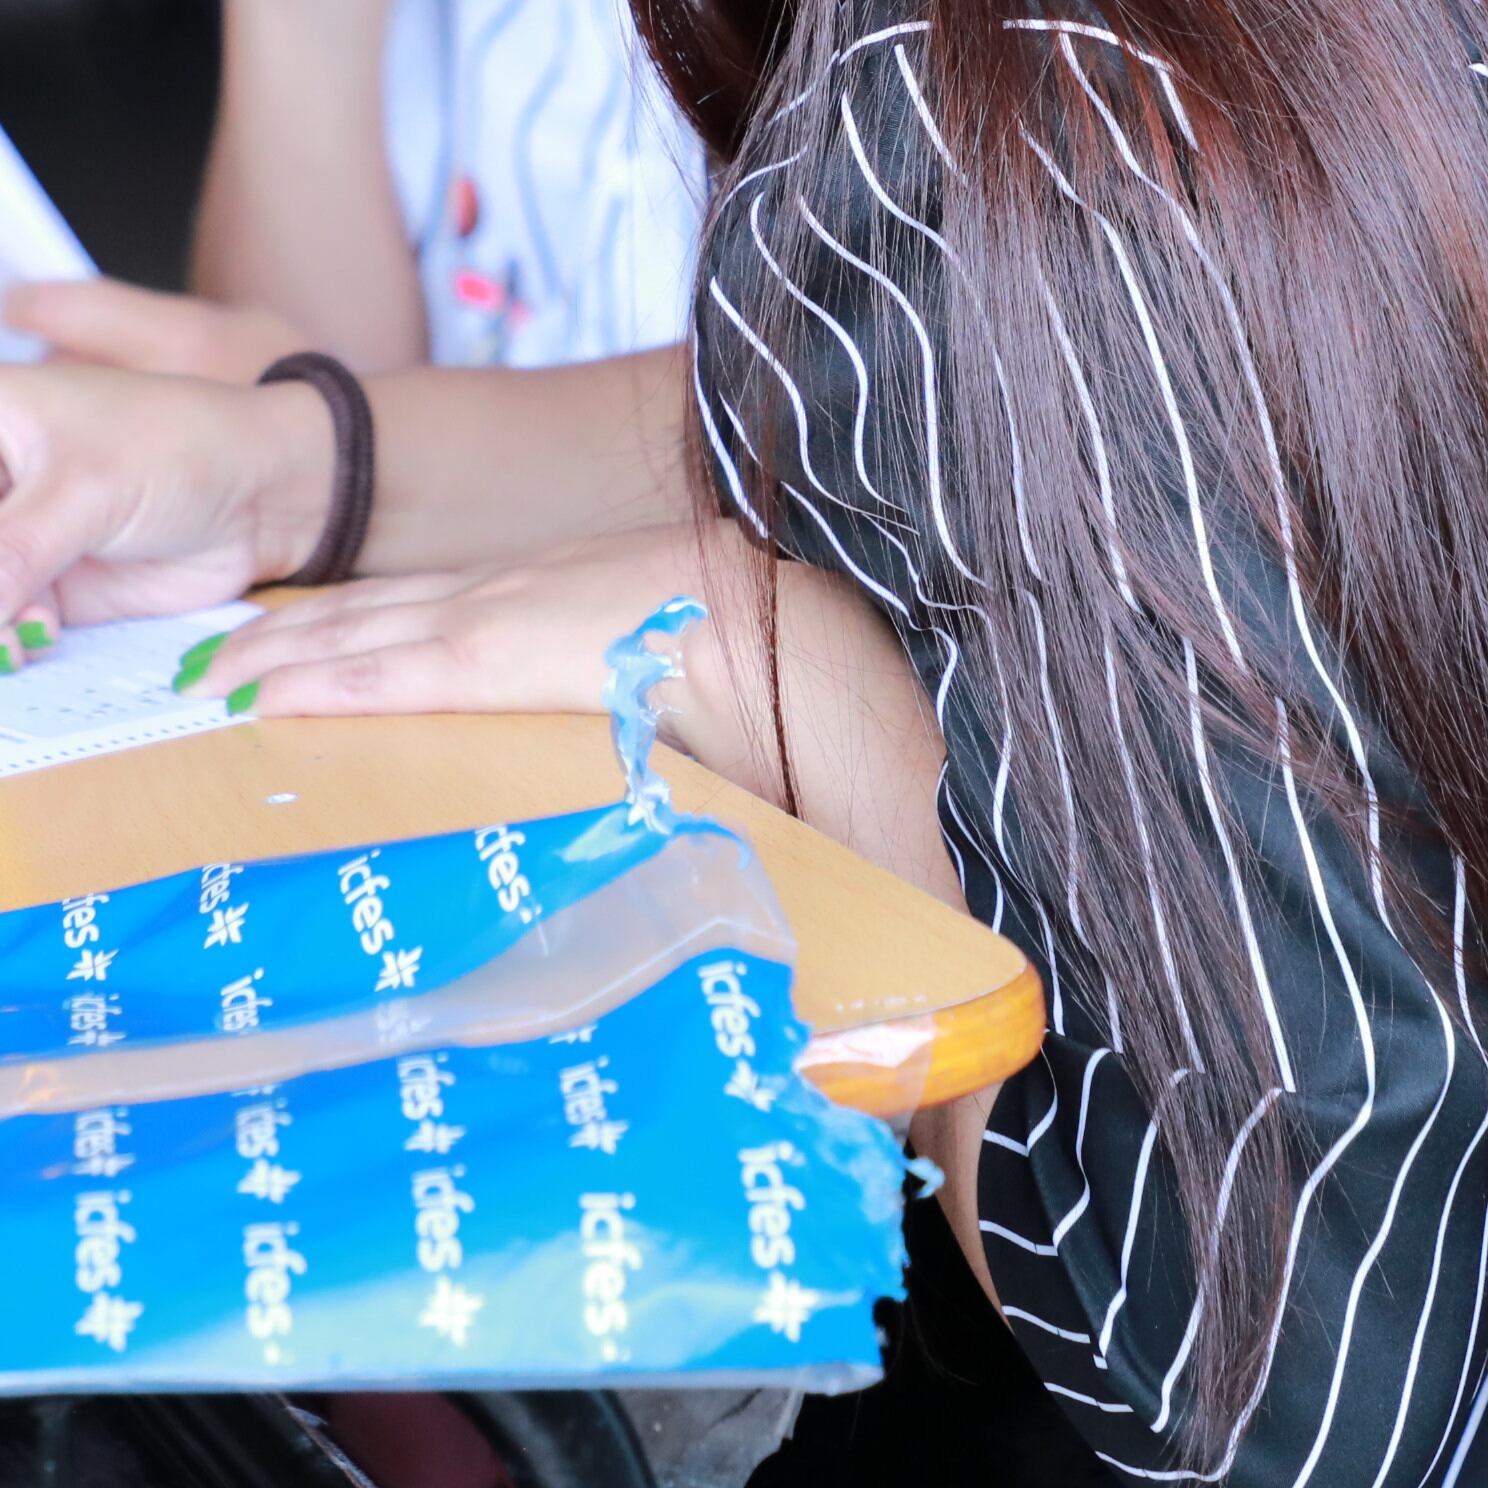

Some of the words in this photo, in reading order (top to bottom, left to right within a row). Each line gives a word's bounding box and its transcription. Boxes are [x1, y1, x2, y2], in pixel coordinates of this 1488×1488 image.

[338, 848, 390, 955] icfes
[69, 993, 123, 1030] icfes
[221, 967, 273, 1032] icfes
[698, 960, 761, 1058] icfes
[74, 1106, 132, 1159] icfes
[235, 1097, 294, 1159] icfes
[397, 1052, 456, 1120] icfes
[560, 1055, 619, 1125] icfes
[74, 1188, 137, 1294] icfes
[412, 1163, 476, 1273] icfes
[738, 1140, 807, 1269] icfes
[244, 1221, 308, 1339] icfes
[578, 1192, 644, 1336] icfes
